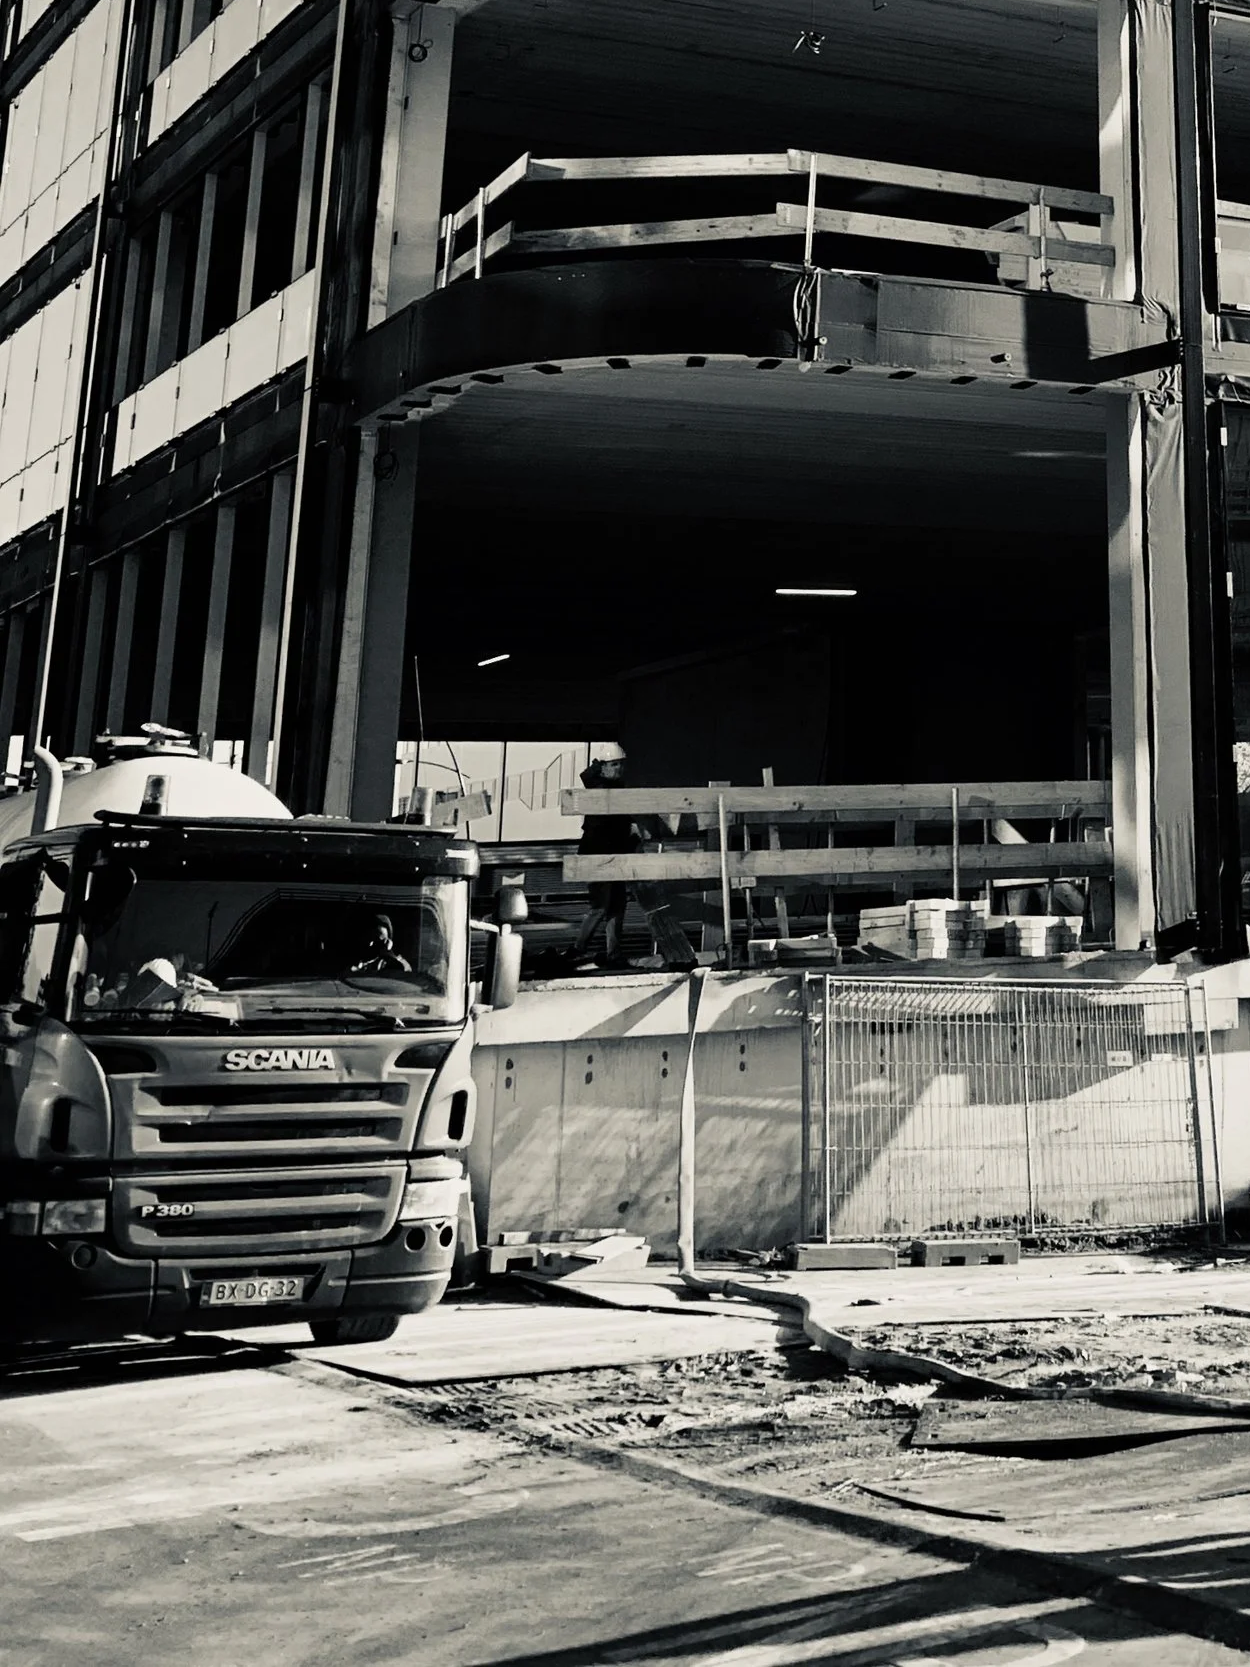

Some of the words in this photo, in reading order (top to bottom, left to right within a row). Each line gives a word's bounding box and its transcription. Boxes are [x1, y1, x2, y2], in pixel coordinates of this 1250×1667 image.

[224, 1048, 336, 1071] SCANIA
[141, 1205, 155, 1218] P
[156, 1203, 195, 1217] 380
[215, 1280, 298, 1301] BX-DG-32
